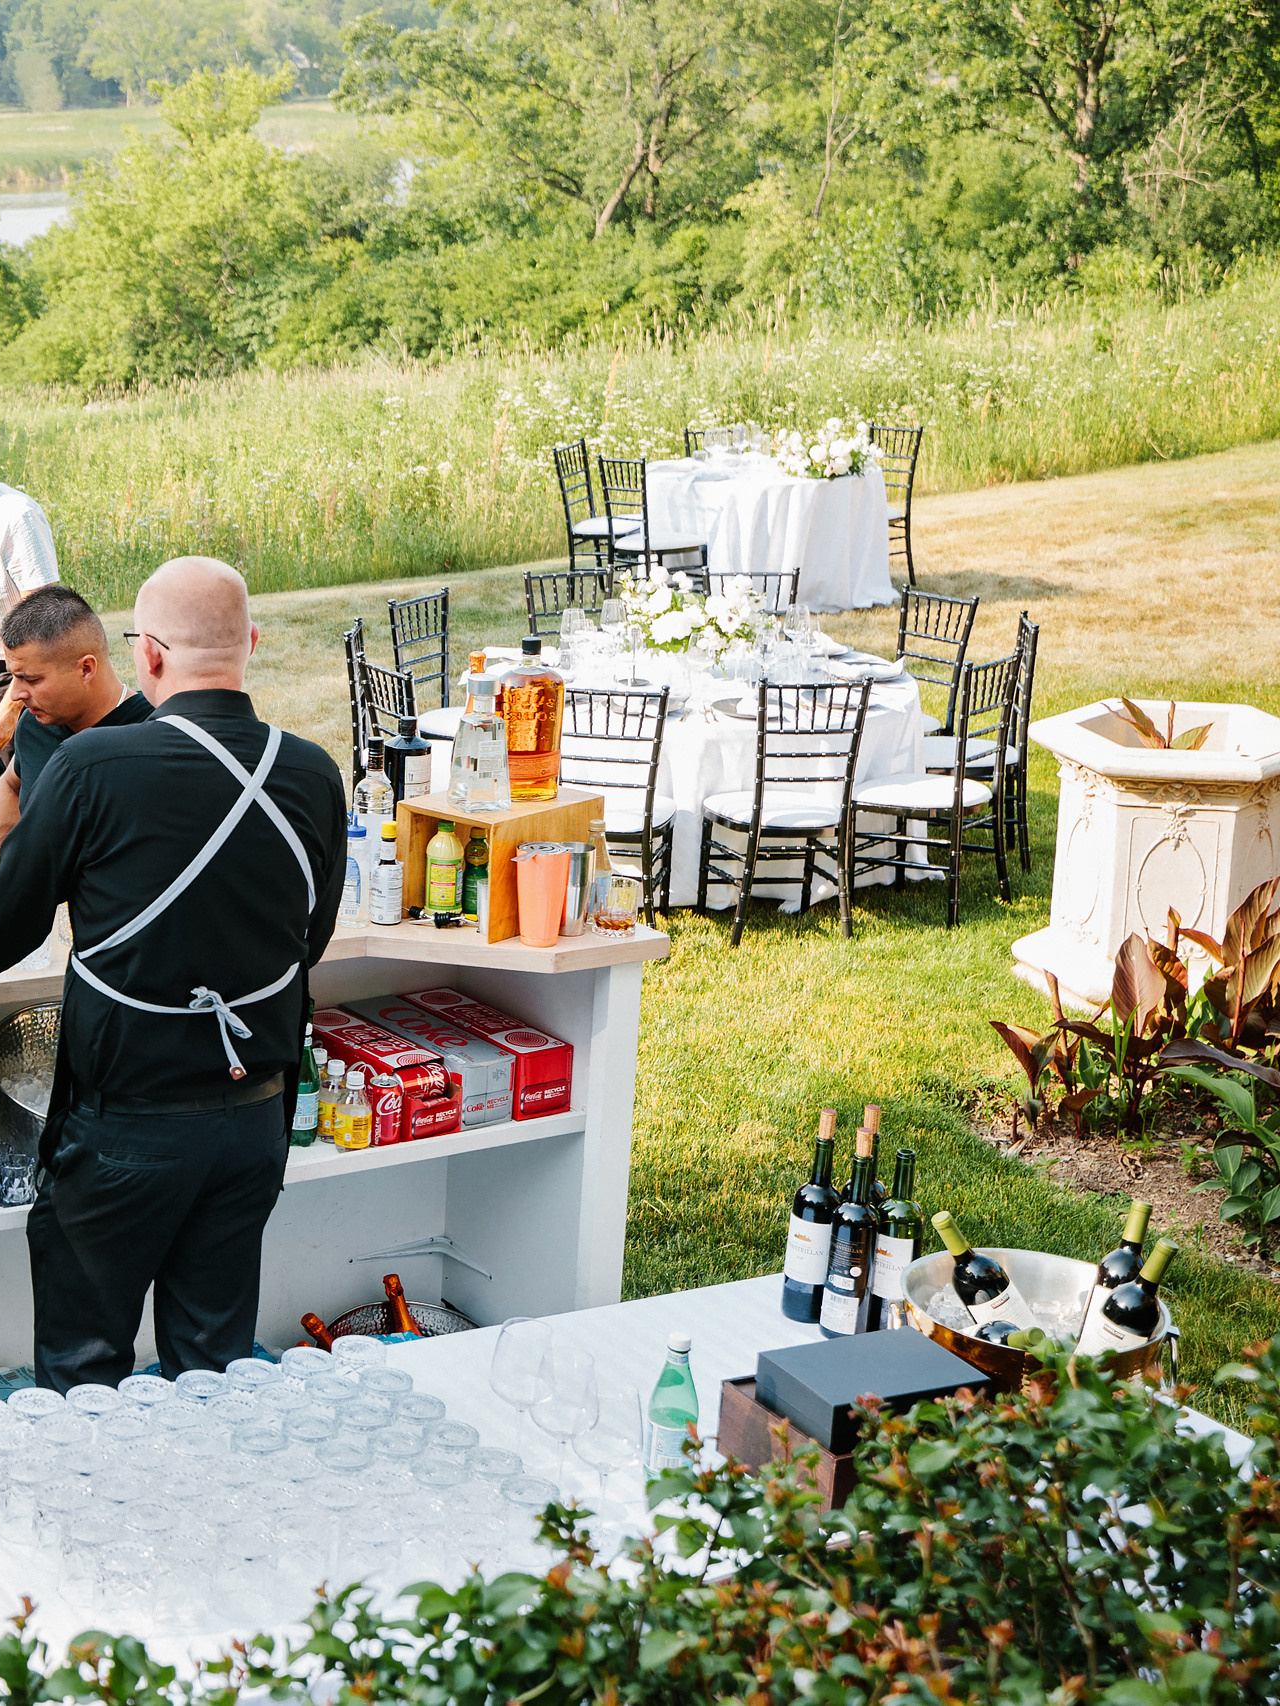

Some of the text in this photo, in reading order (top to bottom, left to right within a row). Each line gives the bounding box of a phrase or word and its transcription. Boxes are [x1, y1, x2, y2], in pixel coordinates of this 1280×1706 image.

[378, 1006, 468, 1049] Coke
[544, 1085, 566, 1094] RECYCLE
[487, 1095, 509, 1104] RECYCLE
[435, 1108, 457, 1117] RECYCLE
[466, 1103, 485, 1113] Coke
